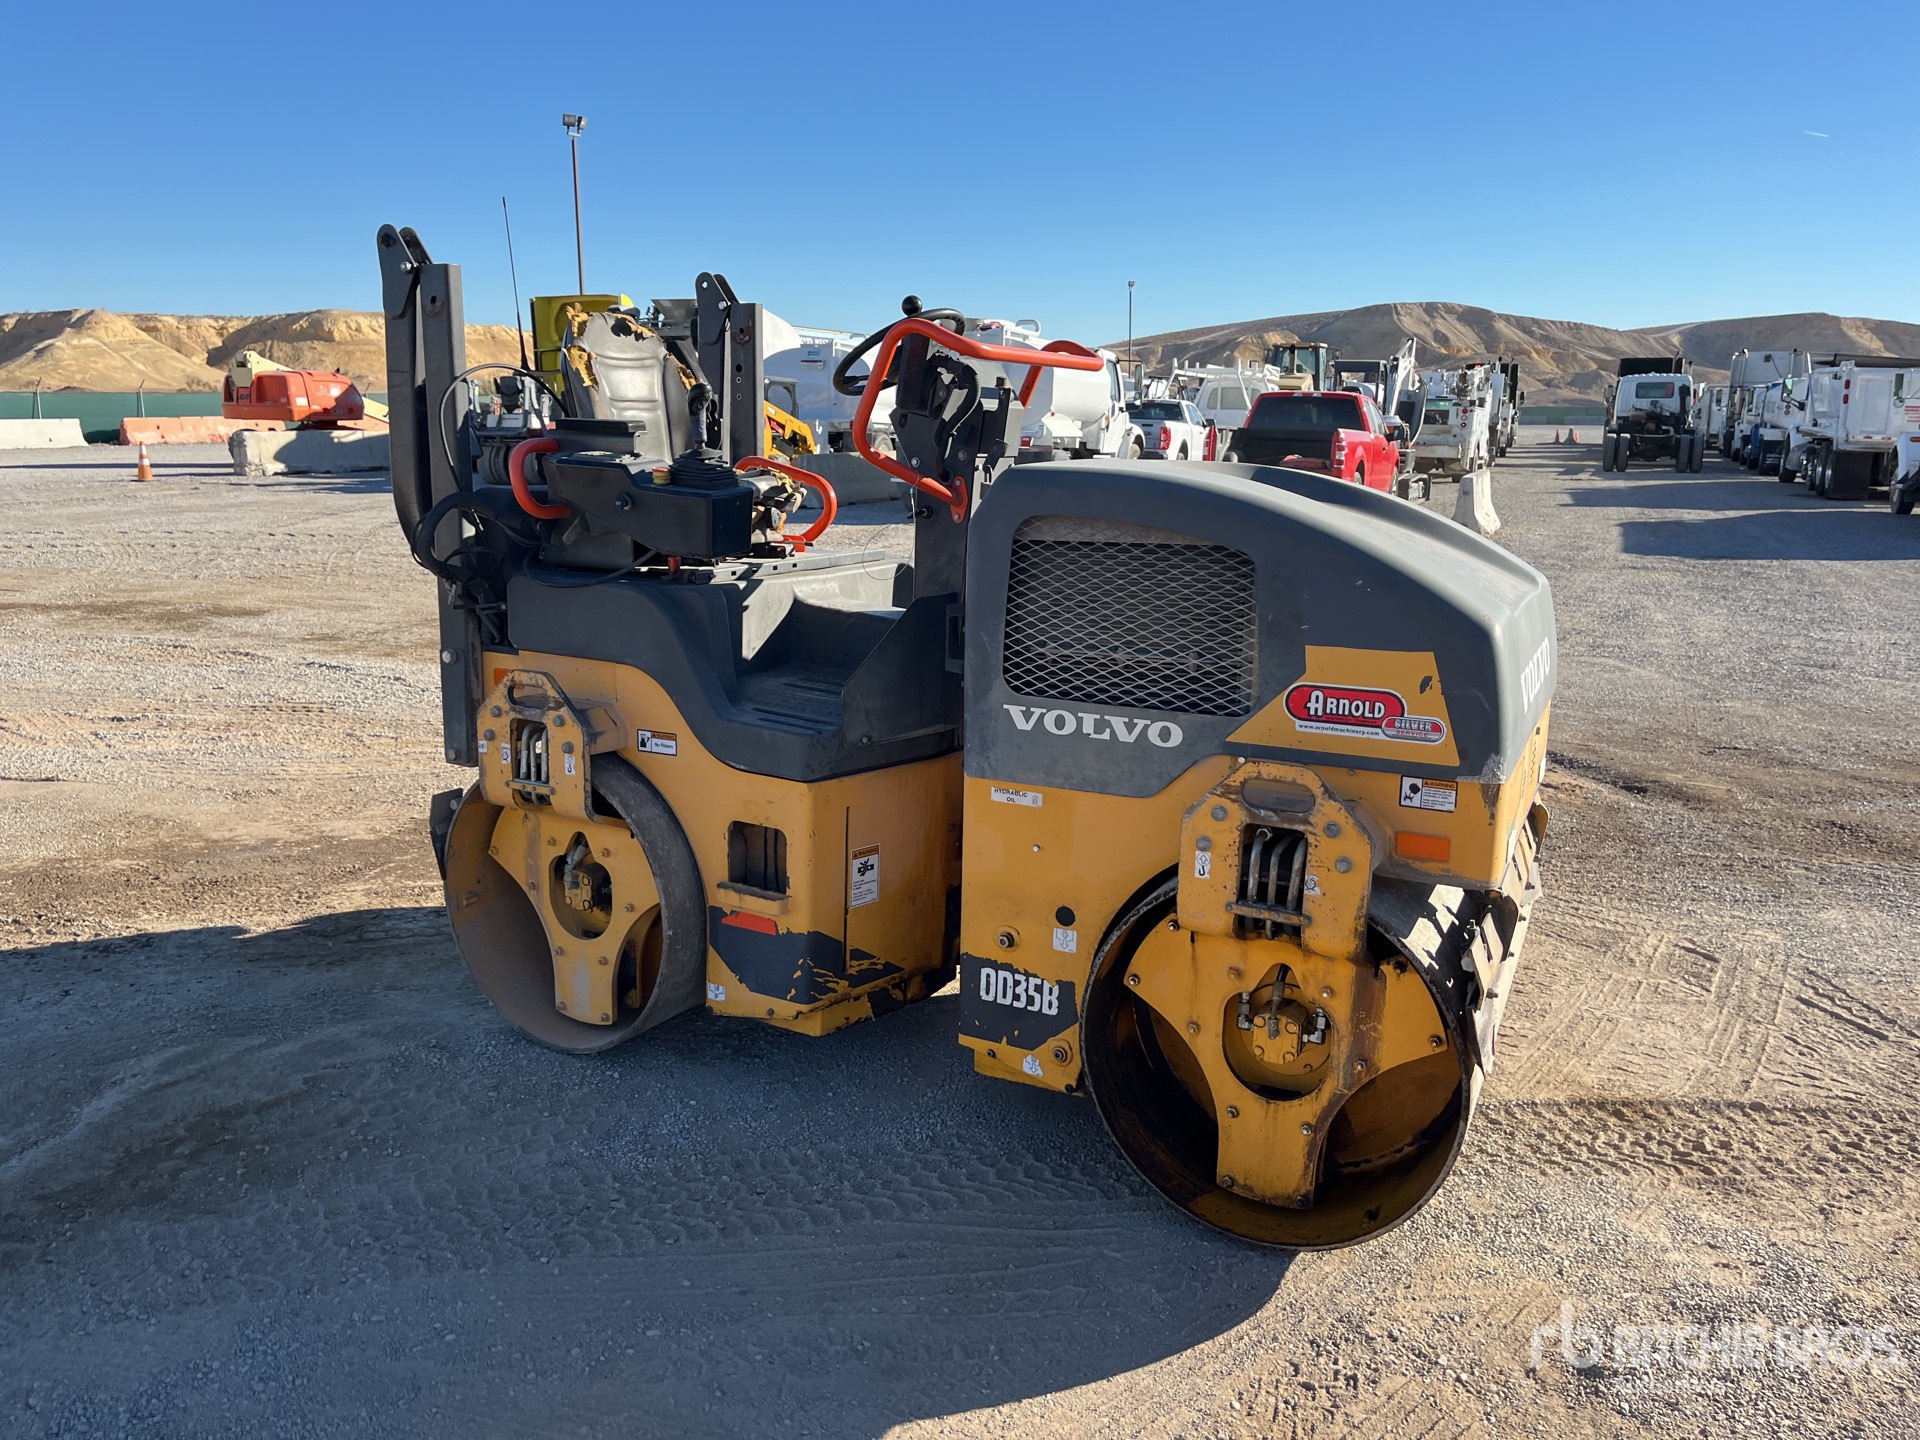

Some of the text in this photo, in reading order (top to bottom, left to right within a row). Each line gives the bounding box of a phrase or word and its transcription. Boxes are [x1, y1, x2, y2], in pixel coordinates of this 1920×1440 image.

[1520, 635, 1551, 714] VOLVO
[1306, 690, 1386, 719] ARNOLD
[1002, 703, 1184, 748] VOLVO
[1298, 723, 1380, 737] www.arnoldmachinery.com
[1394, 718, 1433, 732] SILVER
[1395, 729, 1429, 738] SERVICE
[1429, 781, 1456, 789] WARNING
[994, 788, 1028, 798] HYDRAULIC
[858, 847, 879, 857] WARNING
[979, 967, 1060, 1016] DD35B
